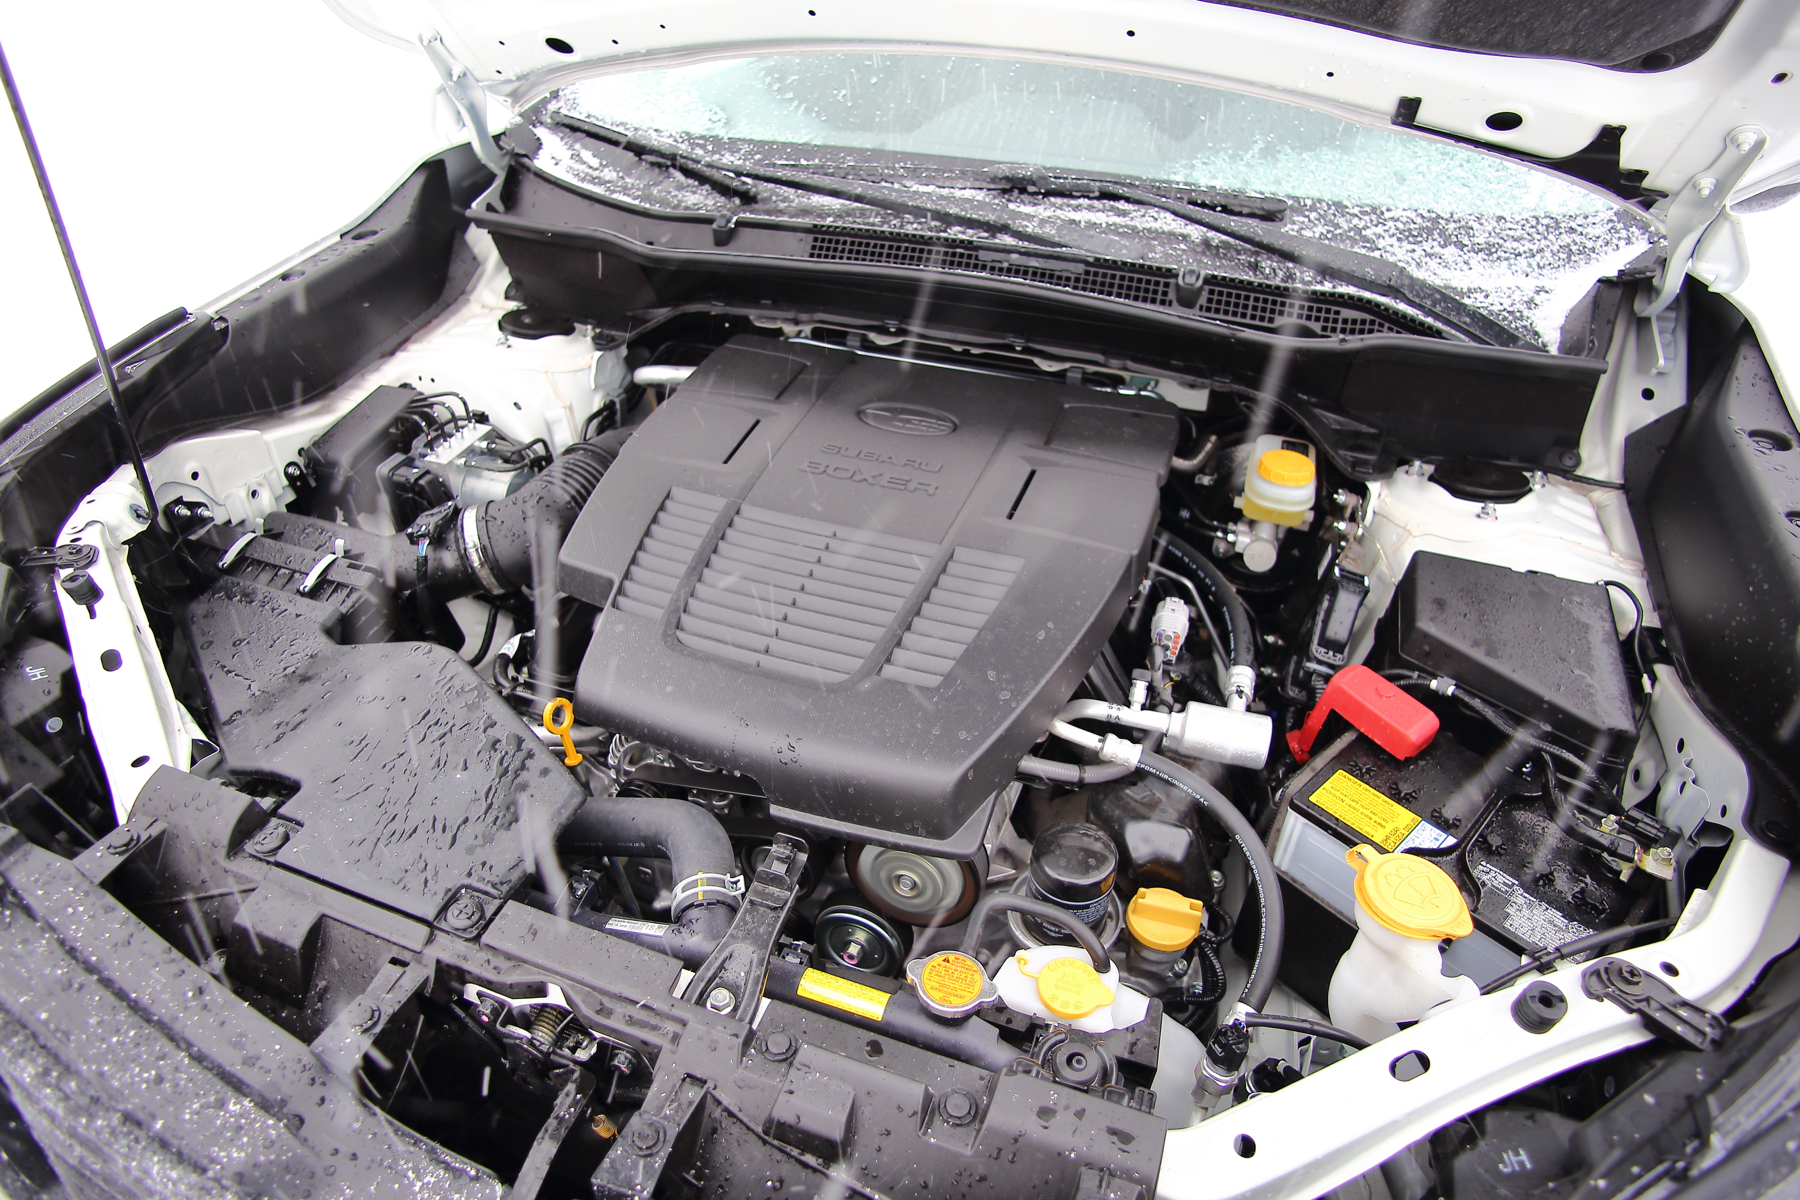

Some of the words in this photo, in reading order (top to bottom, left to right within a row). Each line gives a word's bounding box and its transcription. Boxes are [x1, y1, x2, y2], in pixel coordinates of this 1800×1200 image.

[820, 443, 944, 474] SUBARU
[798, 460, 940, 497] BOXER
[26, 666, 49, 681] JH
[1338, 771, 1362, 788] DANGER
[1321, 786, 1345, 803] POISON
[1337, 813, 1350, 822] REACH
[1355, 824, 1374, 838] CHILDREN
[1048, 959, 1101, 984] COOLANT
[1498, 1148, 1531, 1172] JH
